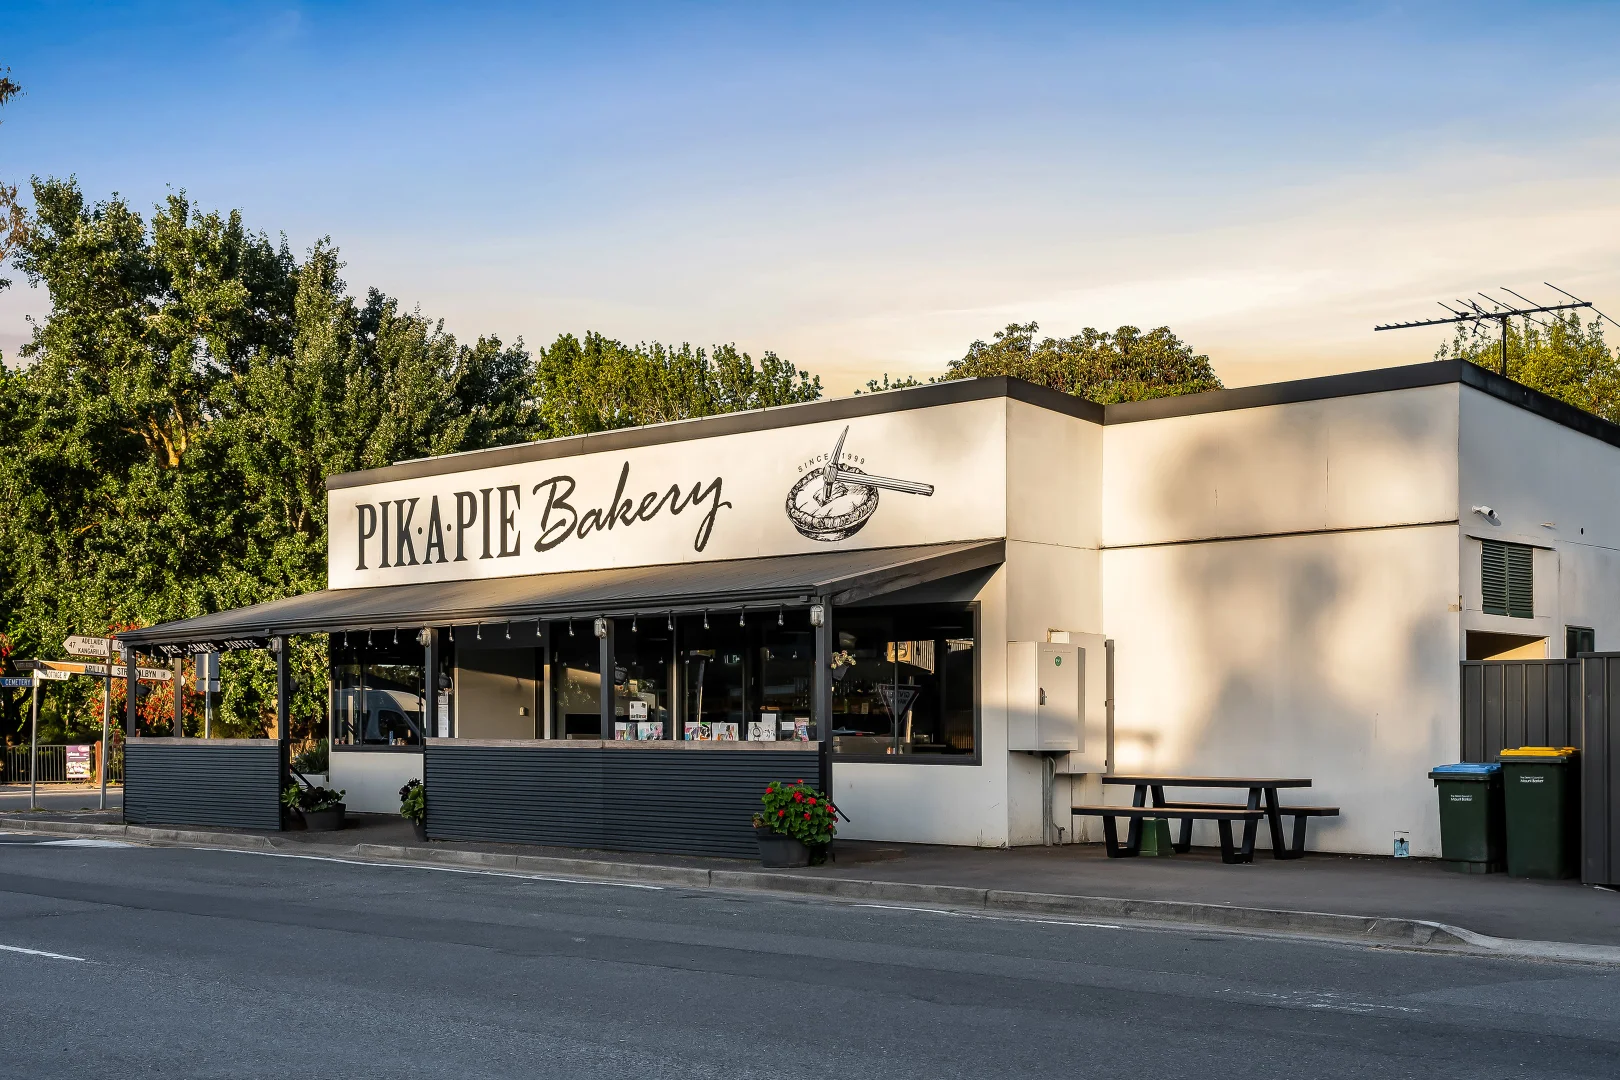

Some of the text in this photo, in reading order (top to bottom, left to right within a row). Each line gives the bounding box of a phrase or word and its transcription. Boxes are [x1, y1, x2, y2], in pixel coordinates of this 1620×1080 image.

[798, 452, 865, 473] SINCE 1999
[532, 461, 733, 553] Bakery
[69, 641, 76, 649] 47
[81, 638, 104, 646] ADELAIDE
[77, 647, 106, 656] KANGARILLA
[188, 642, 218, 653] CAKES
[4, 678, 31, 686] CEMETERY
